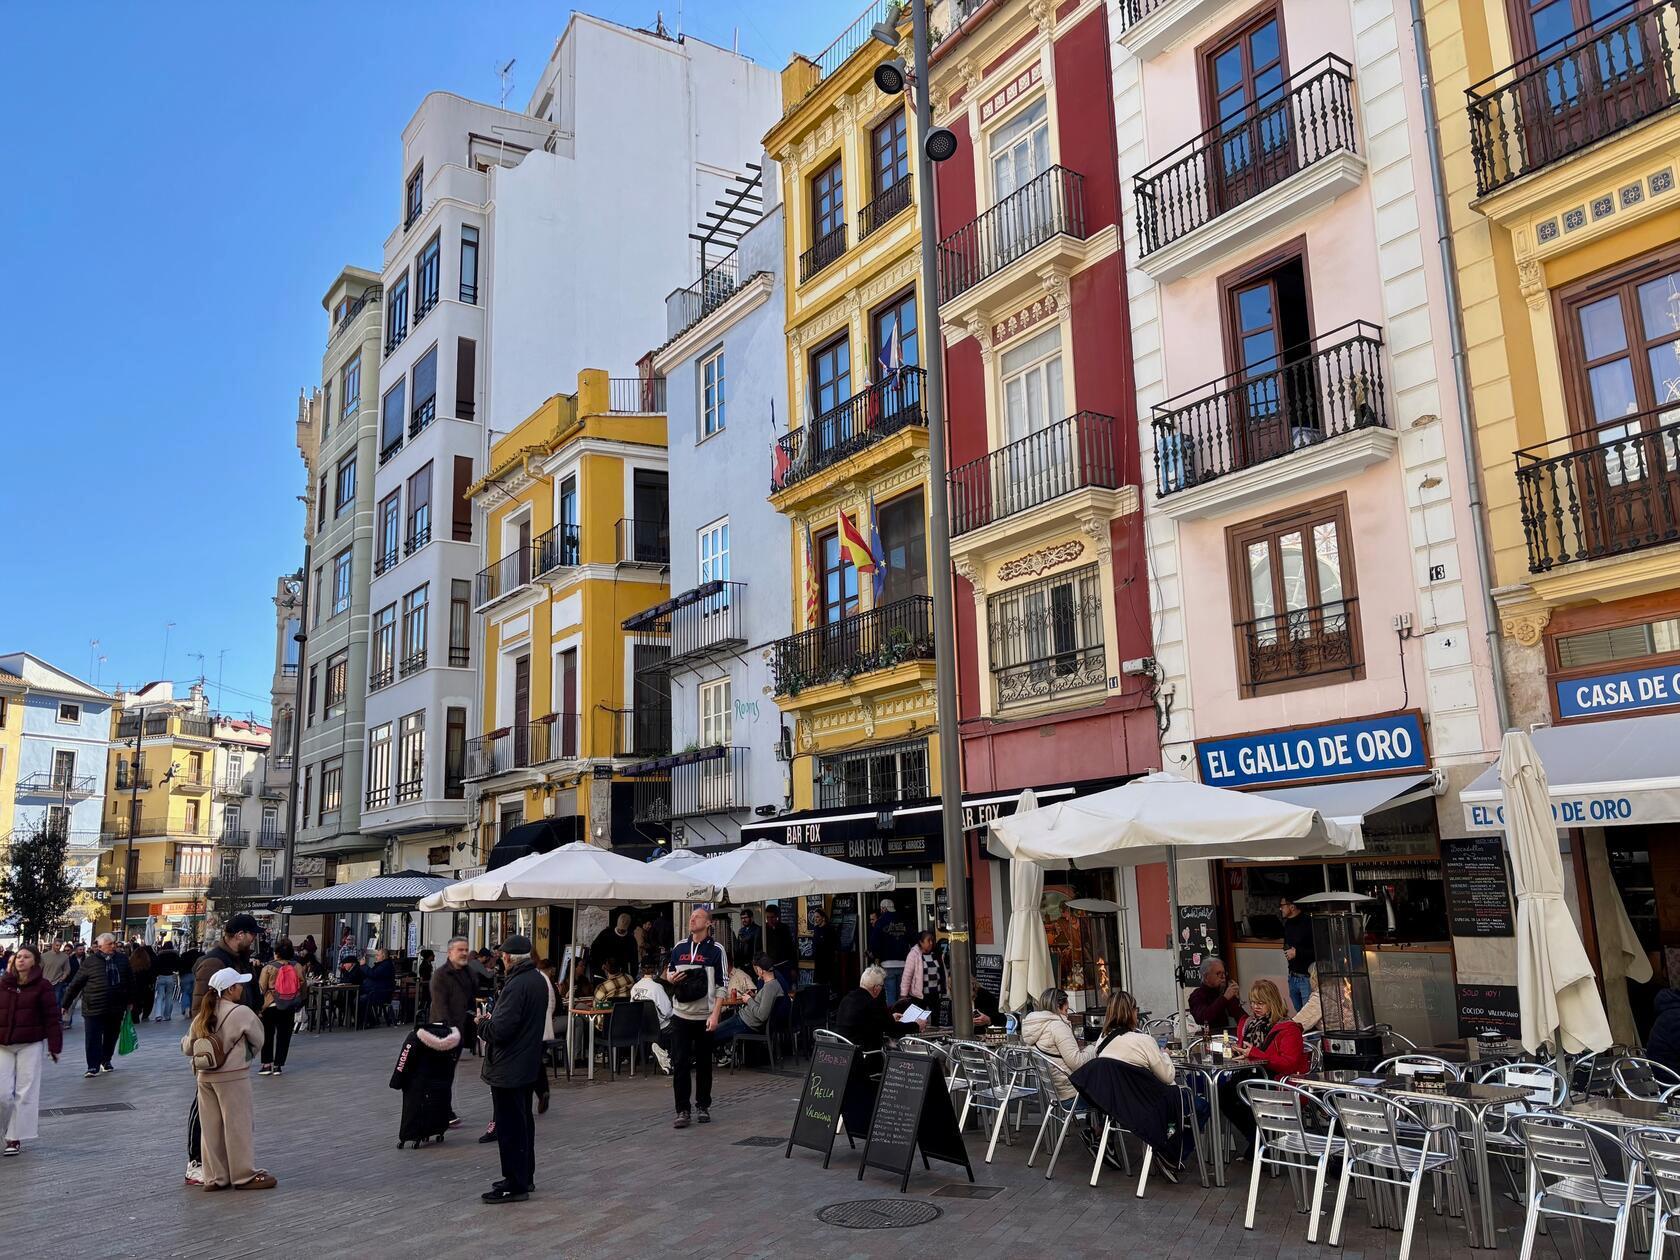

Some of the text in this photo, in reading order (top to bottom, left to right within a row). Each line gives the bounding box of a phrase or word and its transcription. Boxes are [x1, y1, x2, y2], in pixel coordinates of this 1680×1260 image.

[1432, 566, 1445, 580] 13
[1110, 677, 1118, 688] 11
[1576, 680, 1634, 708] CASA
[1638, 675, 1668, 700] DE
[1207, 727, 1412, 779] EL GALLO DE ORO
[961, 804, 1000, 828] AR FOX
[1472, 806, 1494, 825] EL
[1562, 801, 1586, 822] DE
[1590, 798, 1632, 821] ORO
[786, 824, 821, 844] BAR FOX
[848, 838, 884, 858] BAR FOX
